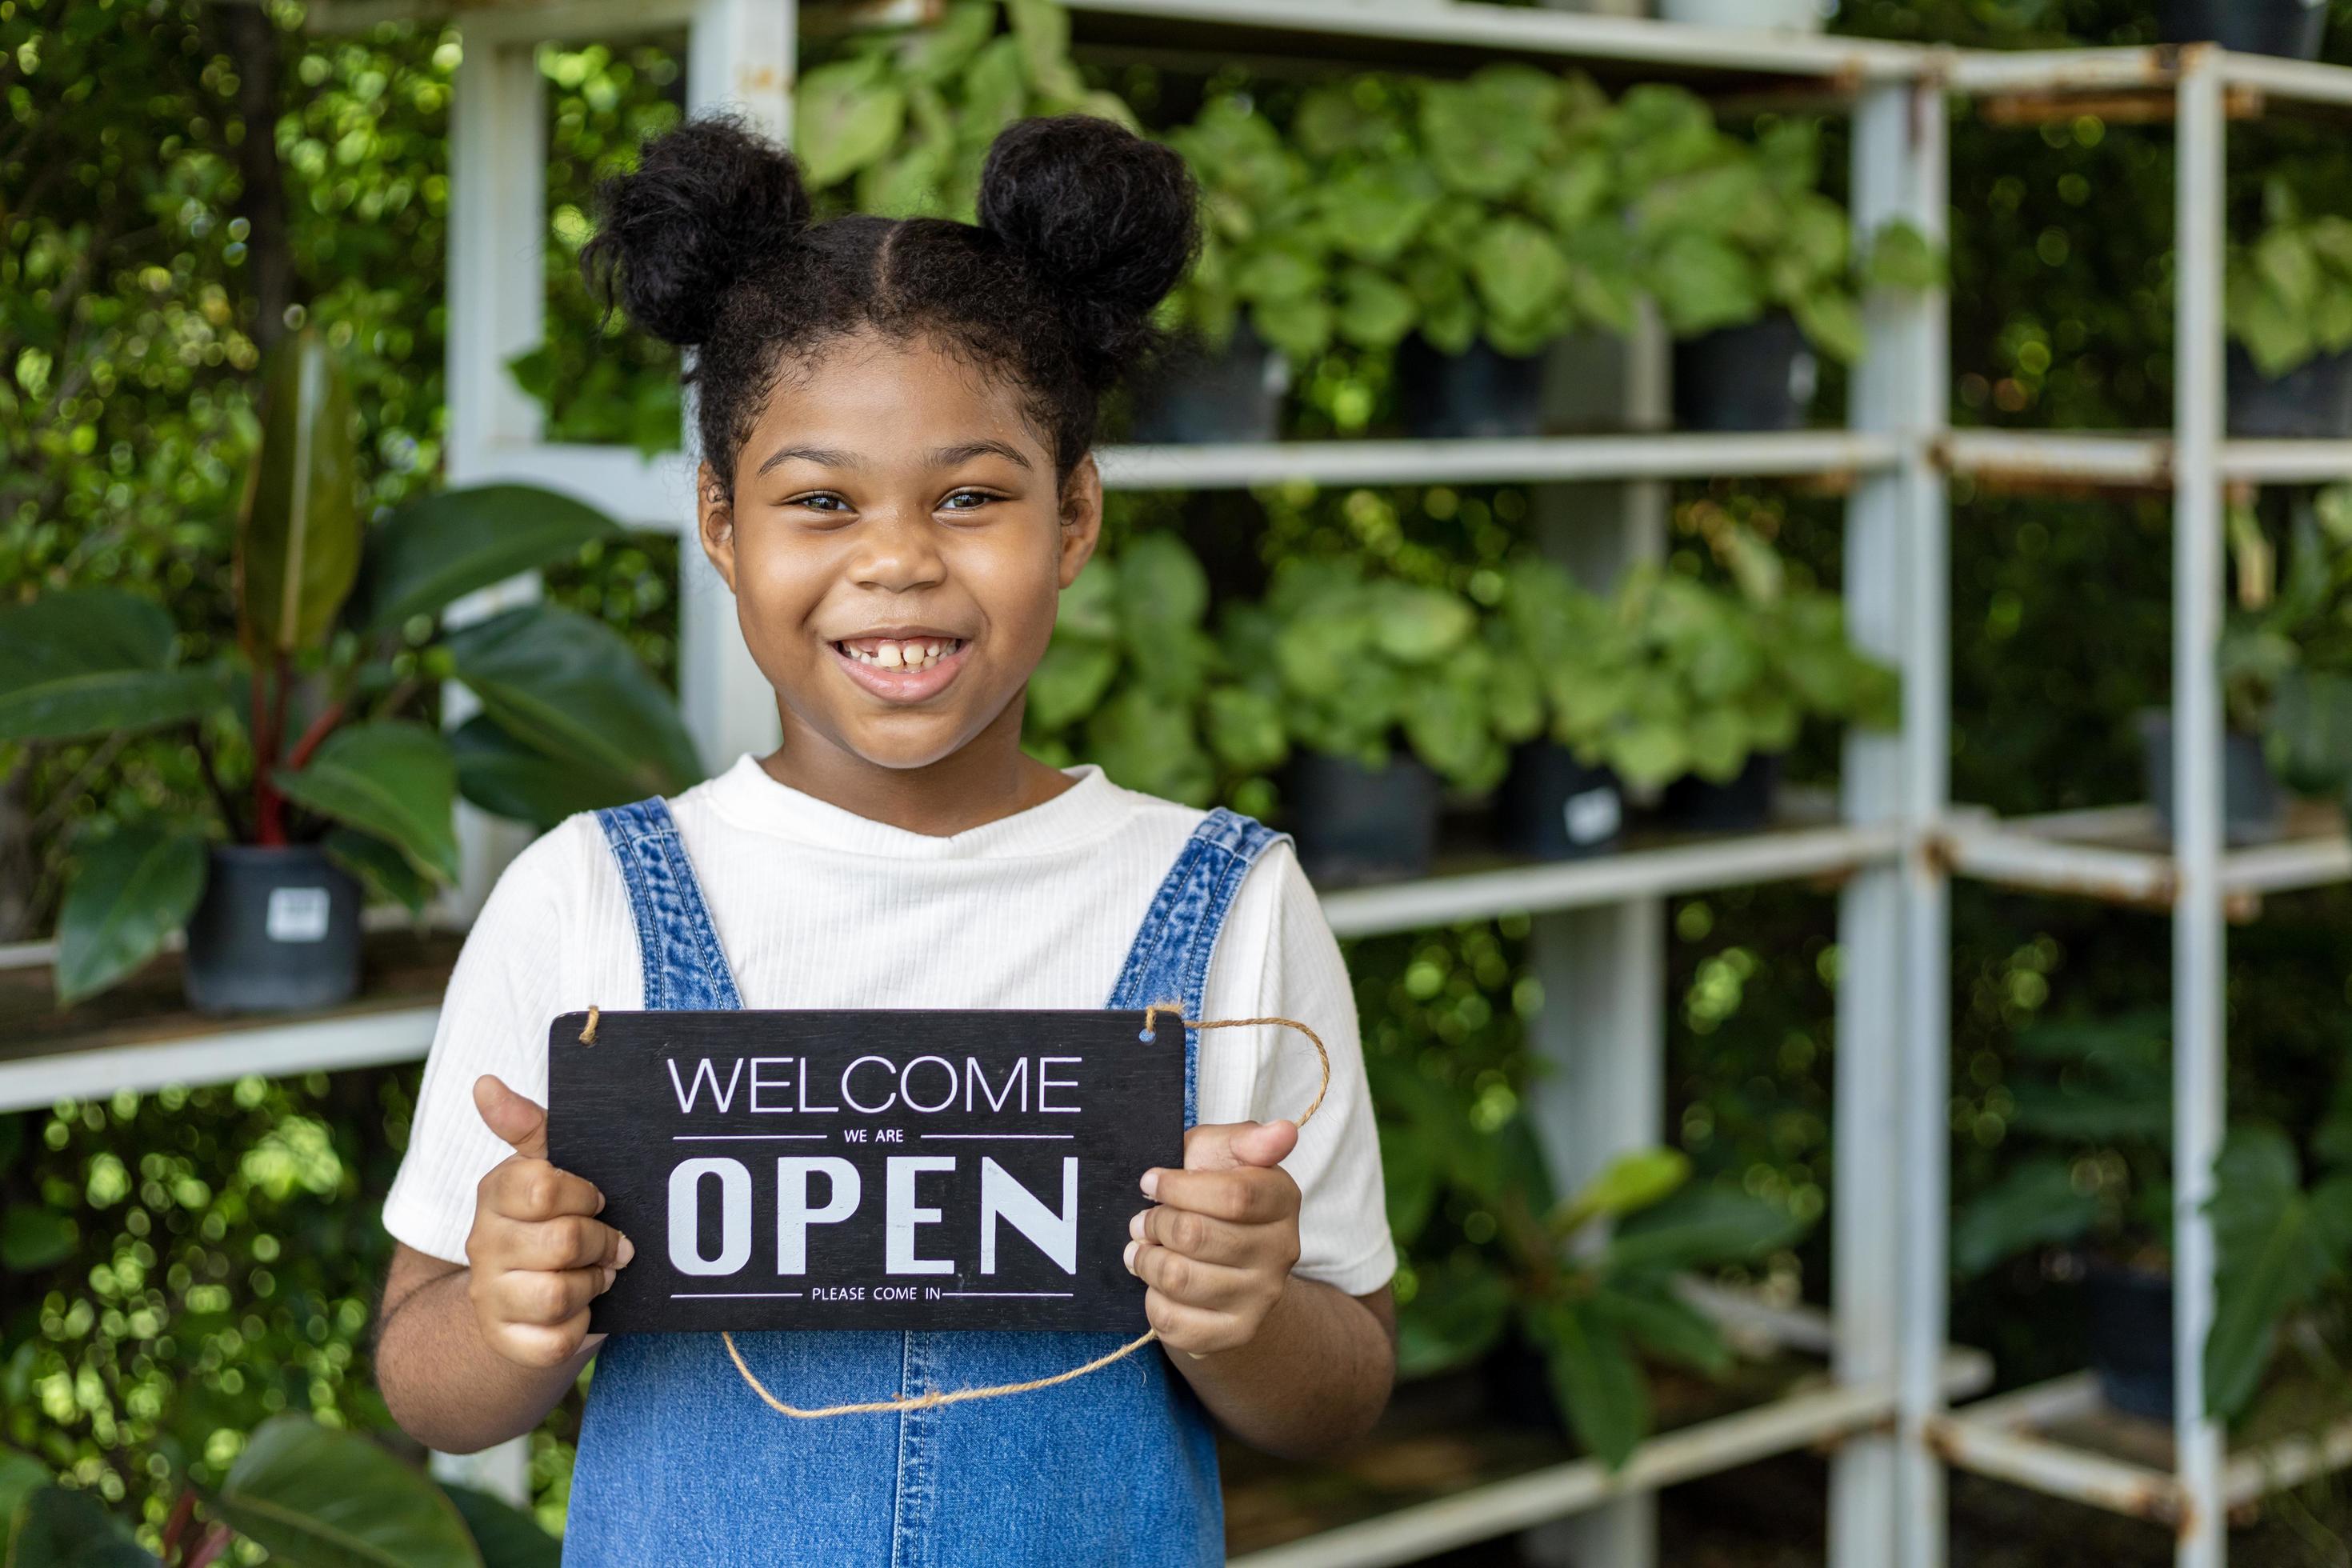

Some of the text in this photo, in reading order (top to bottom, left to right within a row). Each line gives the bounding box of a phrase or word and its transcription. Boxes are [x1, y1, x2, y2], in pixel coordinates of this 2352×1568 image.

[666, 1055, 1082, 1114] WELCOME
[844, 1129, 904, 1142] WE ARE
[667, 1156, 1078, 1276] OPEN
[812, 1286, 941, 1301] PLEASE COME IN
